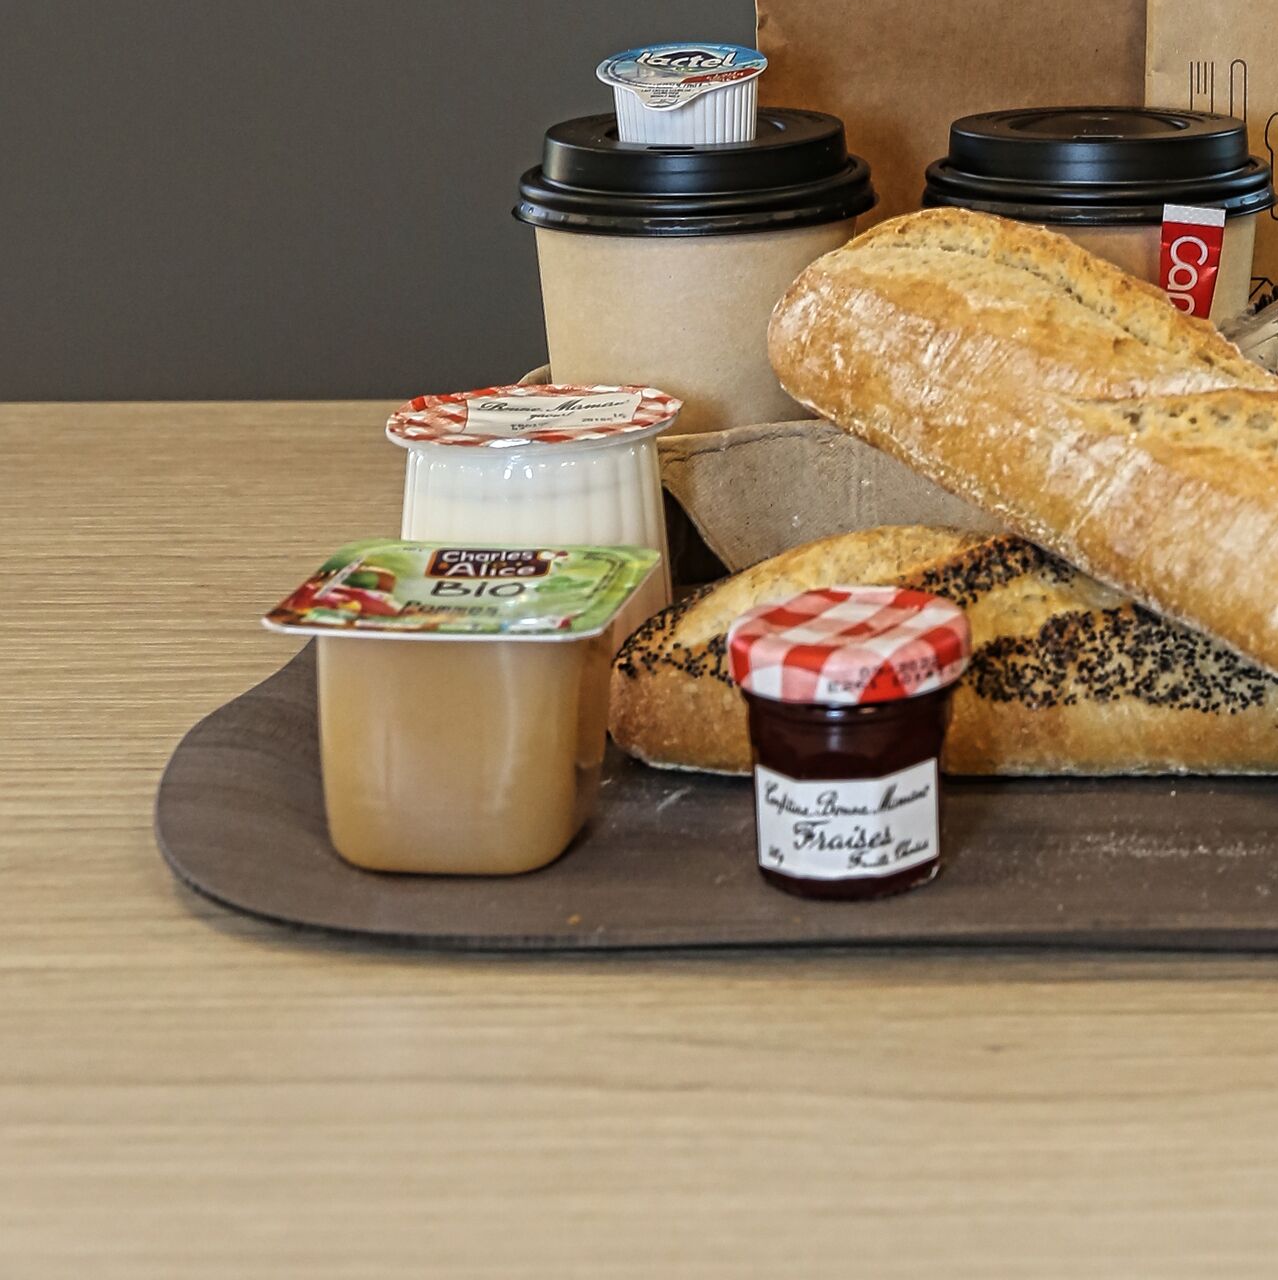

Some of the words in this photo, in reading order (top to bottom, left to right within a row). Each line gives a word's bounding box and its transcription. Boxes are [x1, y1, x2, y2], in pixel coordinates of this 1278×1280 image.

[636, 51, 736, 69] lactel
[442, 550, 534, 563] Charles
[445, 562, 537, 577] Alice
[793, 820, 896, 851] Fraises
